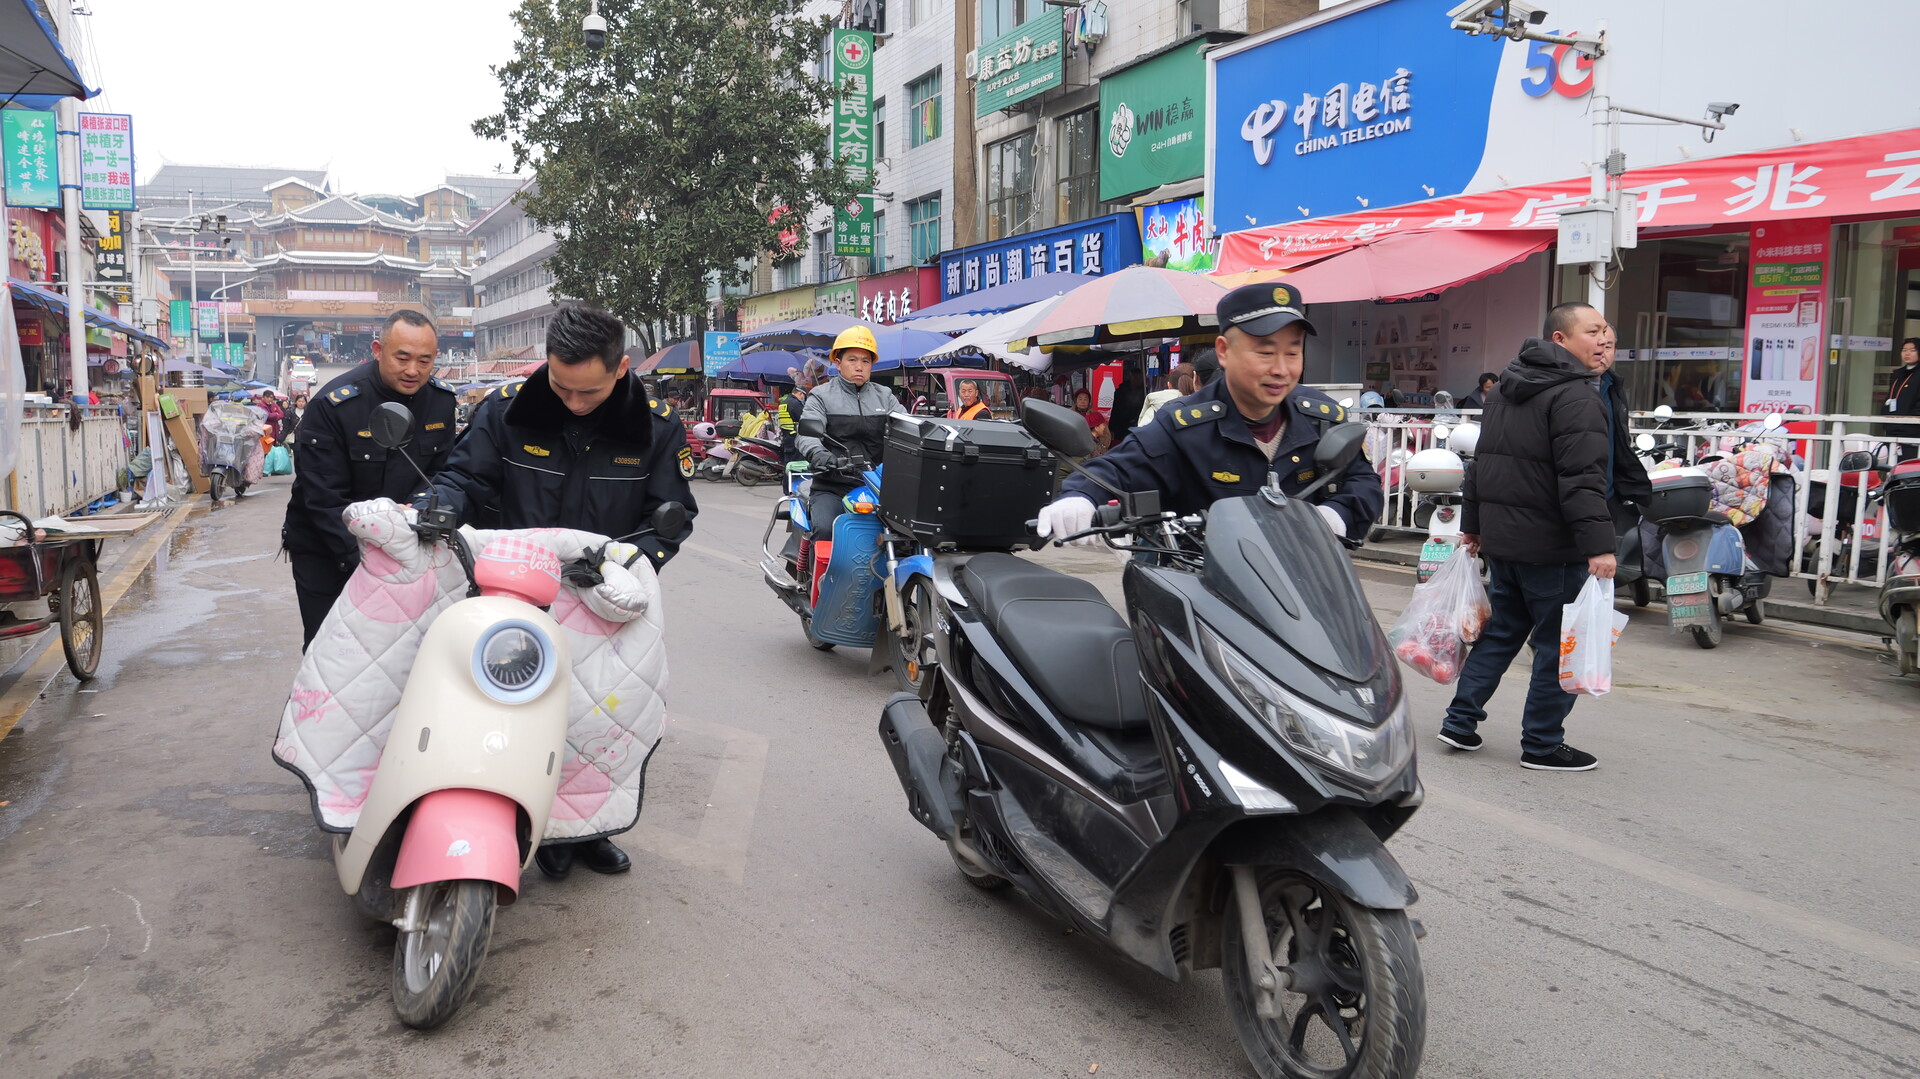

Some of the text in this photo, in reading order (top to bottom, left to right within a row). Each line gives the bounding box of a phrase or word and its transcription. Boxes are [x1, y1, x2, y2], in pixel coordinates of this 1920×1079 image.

[978, 36, 1034, 81] 康益坊
[1520, 29, 1594, 98] 5G
[1294, 67, 1412, 141] 中国电信
[81, 116, 129, 131] 桑植张波口腔
[86, 133, 124, 149] 种植牙
[1295, 116, 1412, 155] CHINA TELECOM
[82, 149, 130, 168] 种一送一
[84, 187, 131, 201] 桑植张波口腔
[838, 234, 871, 246] 卫生室
[1173, 210, 1214, 259] 牛肉
[1756, 243, 1823, 258] 小米科技年货节
[946, 232, 1102, 295] 新时尚潮流百货
[717, 335, 728, 349] P
